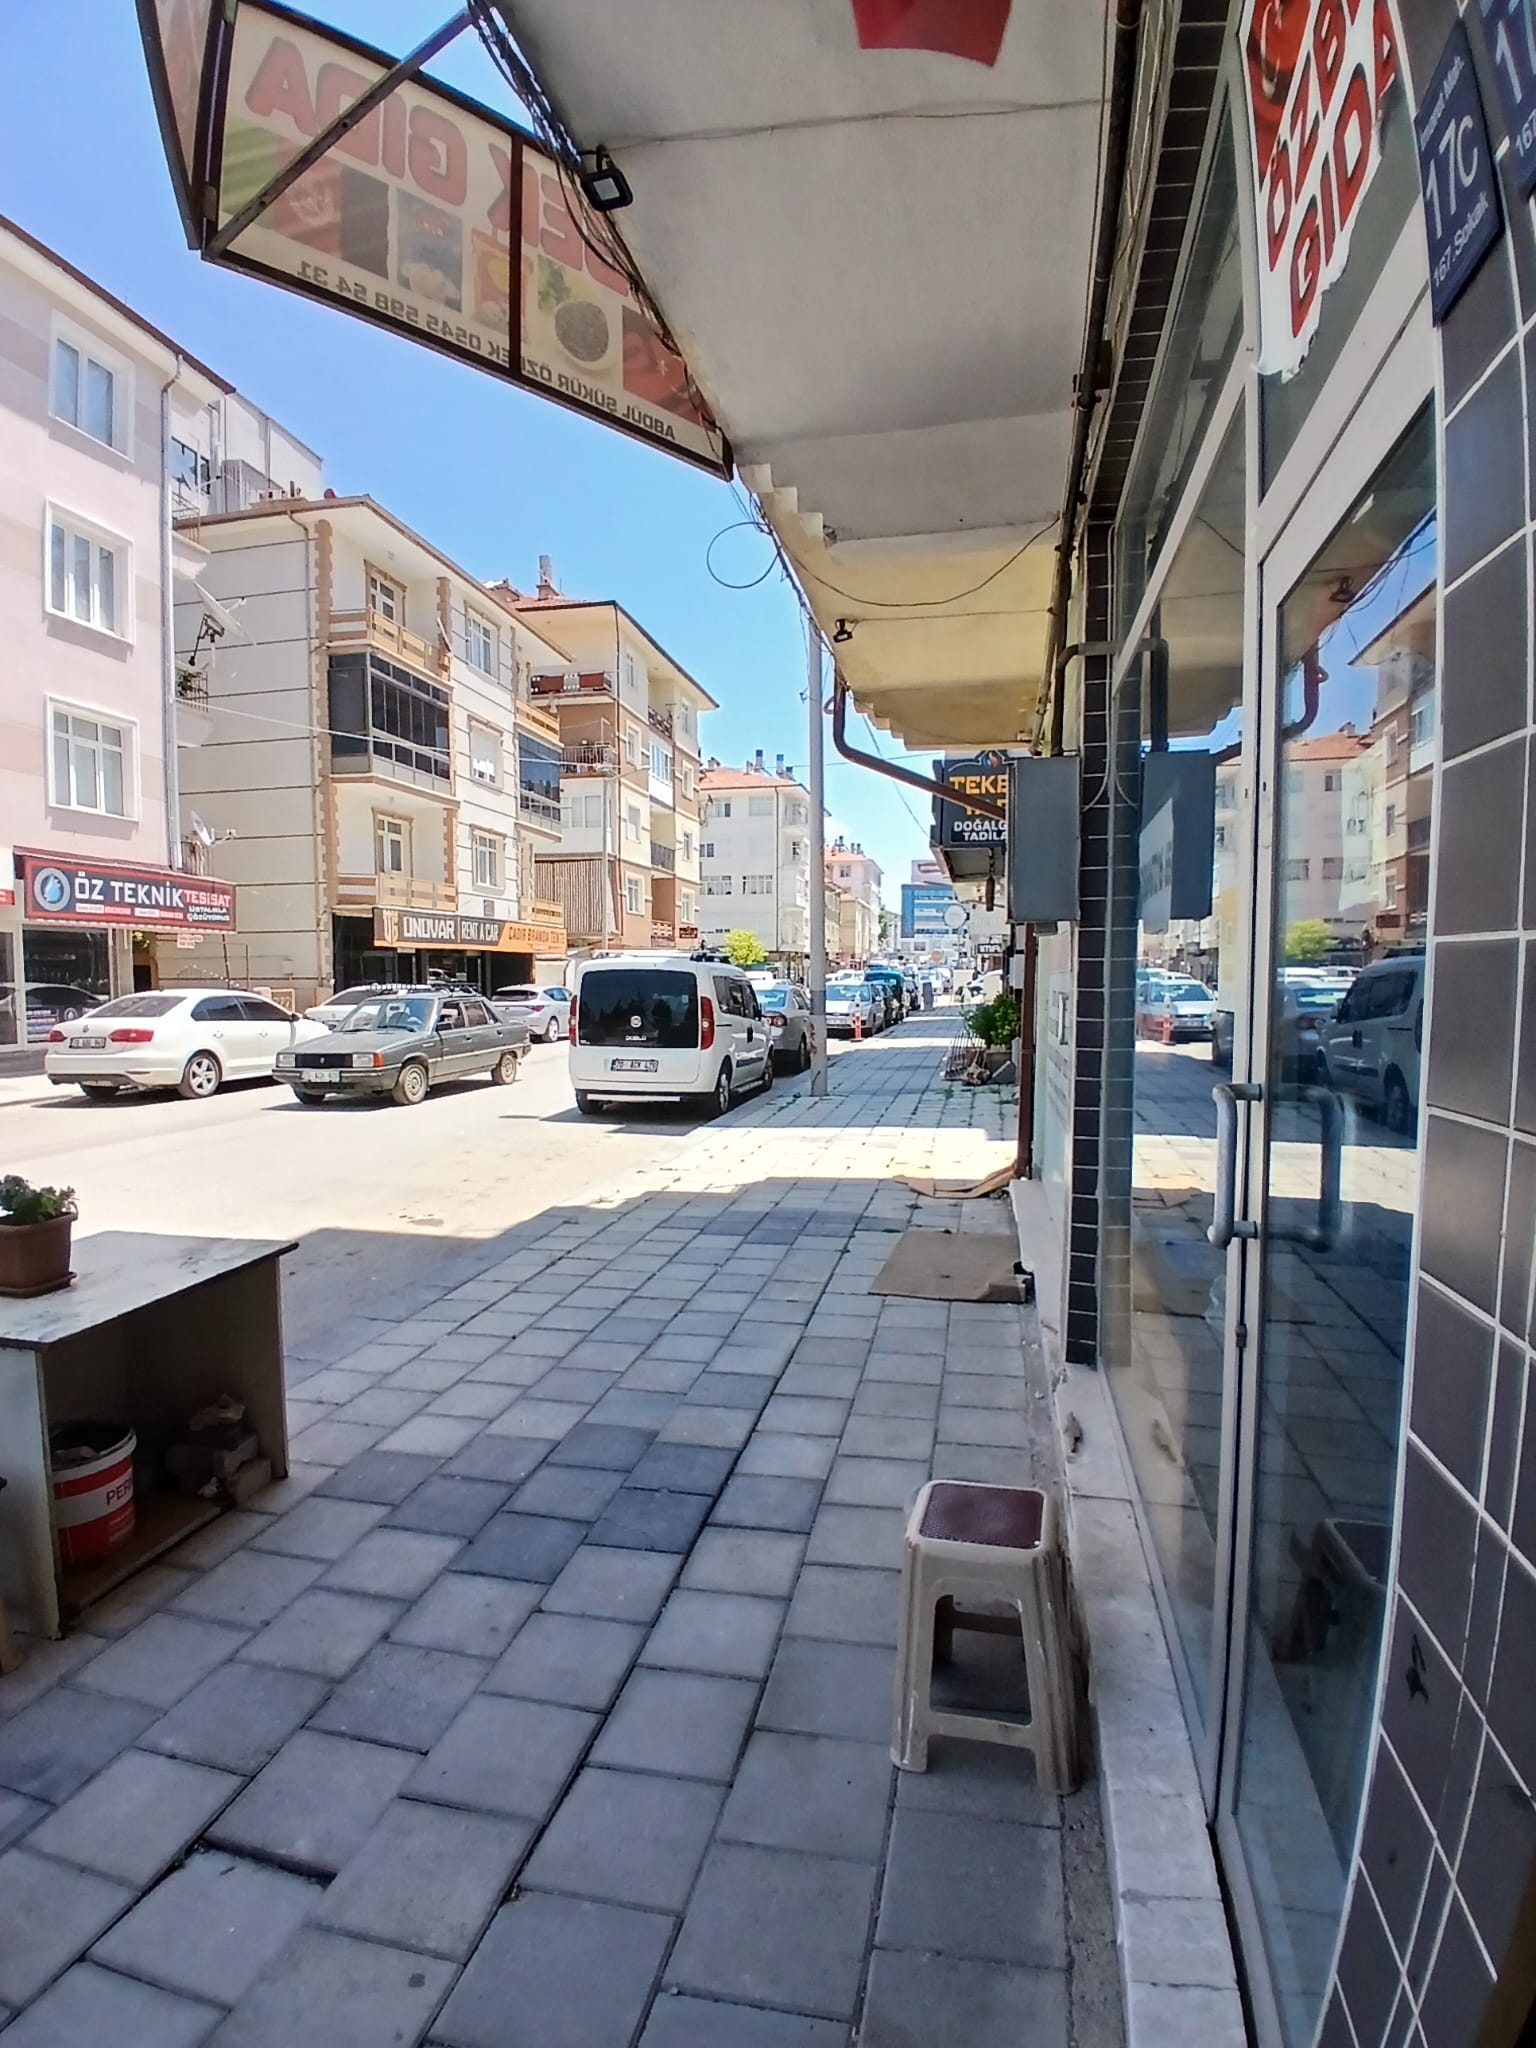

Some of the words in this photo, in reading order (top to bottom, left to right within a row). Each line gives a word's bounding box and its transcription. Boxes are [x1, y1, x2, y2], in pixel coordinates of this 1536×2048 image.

[1426, 115, 1478, 240] 17C
[74, 871, 104, 901] ÖZ
[110, 880, 184, 908] TEKNİK
[461, 921, 478, 940] RENT
[485, 923, 499, 942] CAR
